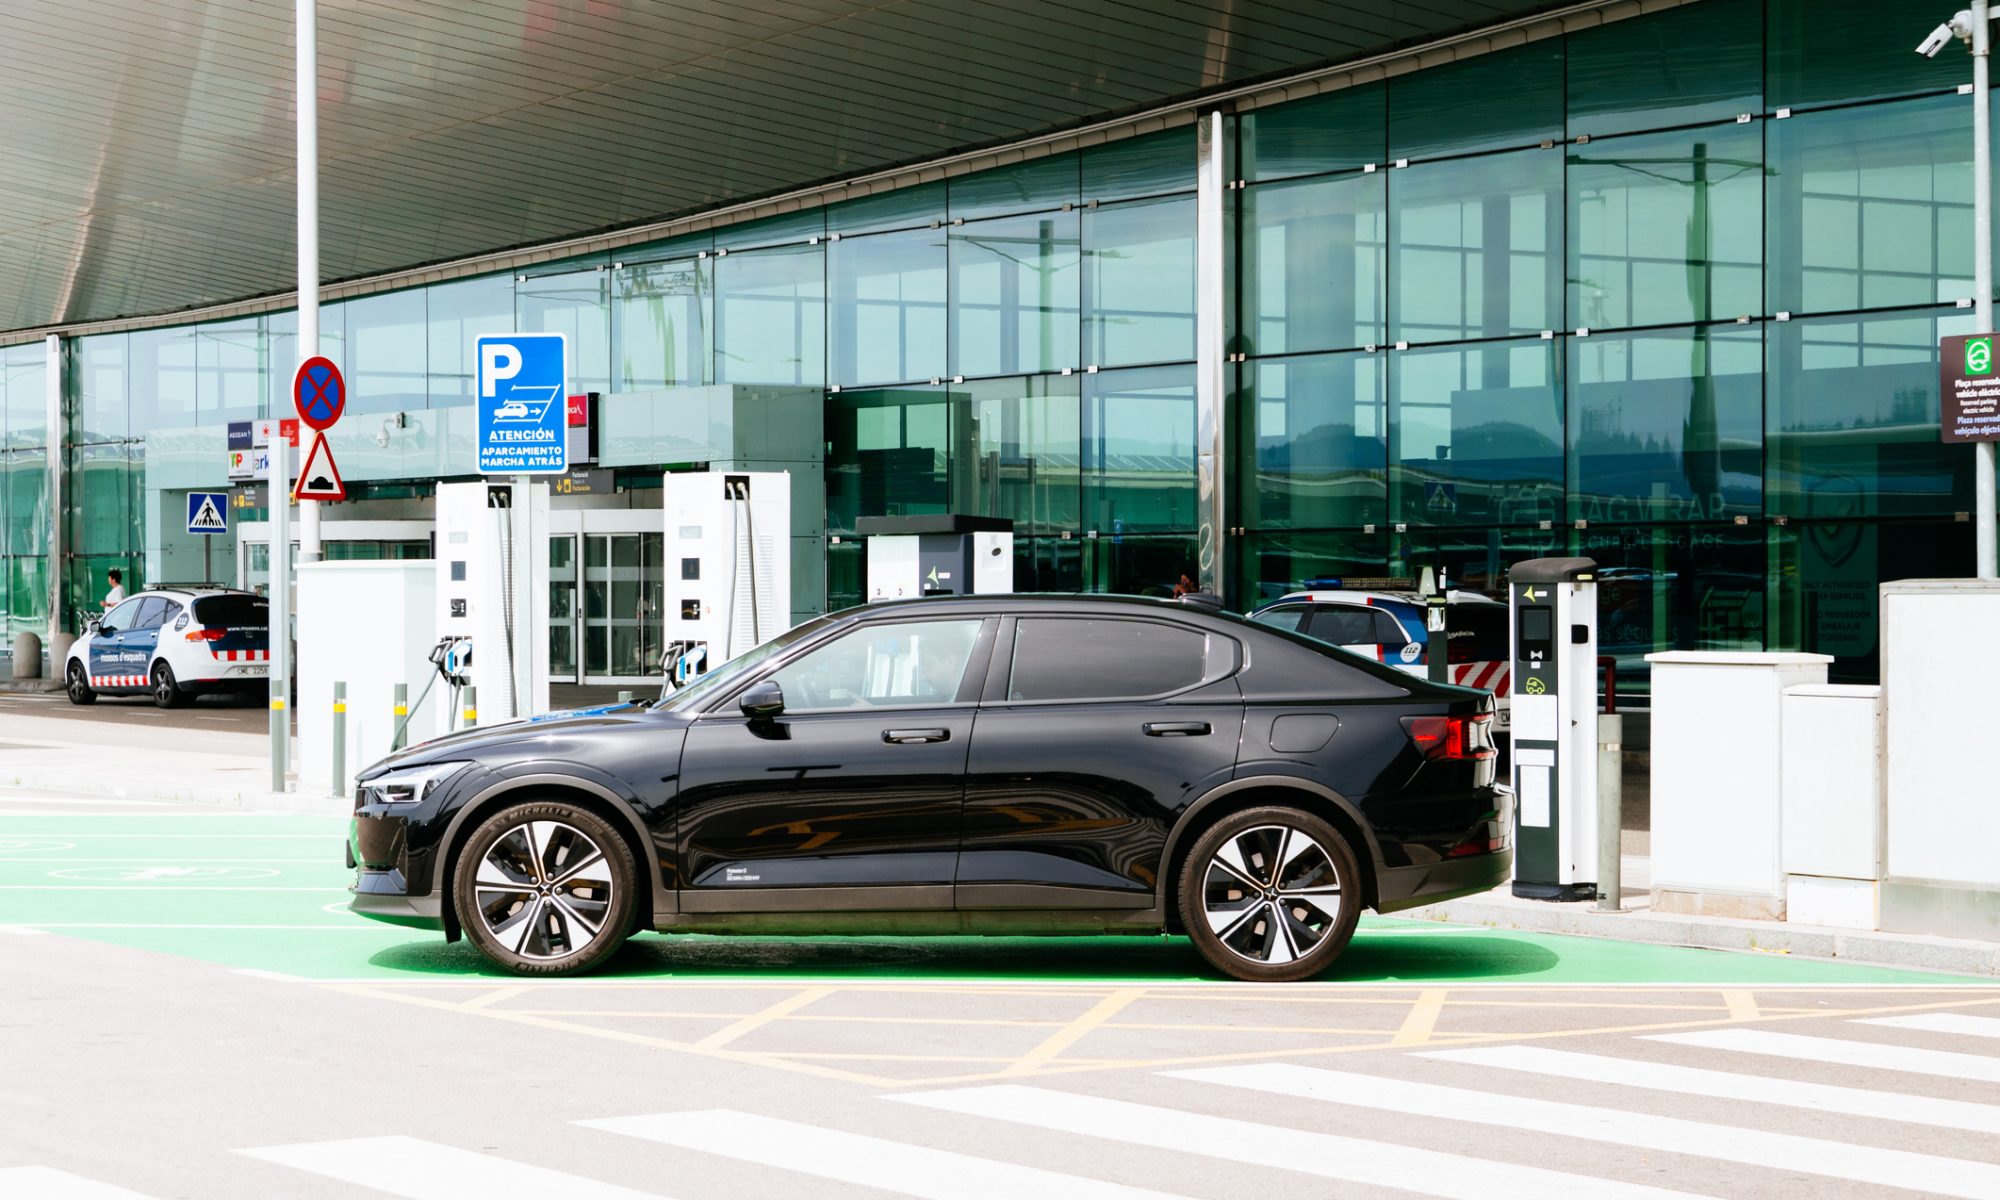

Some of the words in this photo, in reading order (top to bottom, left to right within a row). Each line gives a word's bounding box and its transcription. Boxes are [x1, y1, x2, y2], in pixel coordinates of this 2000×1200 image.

[482, 344, 522, 397] P
[1954, 379, 1972, 389] Plaça
[1972, 377, 2000, 386] reservad
[1957, 416, 1973, 424] Plaza
[229, 431, 247, 439] AEGEAN
[489, 427, 555, 440] ATENCIÓN
[482, 447, 562, 456] APARCAMIENTO
[481, 458, 526, 467] MARCHA
[528, 456, 563, 466] ATRÁS
[1404, 646, 1418, 654] 112
[509, 806, 571, 821] MICHELIN
